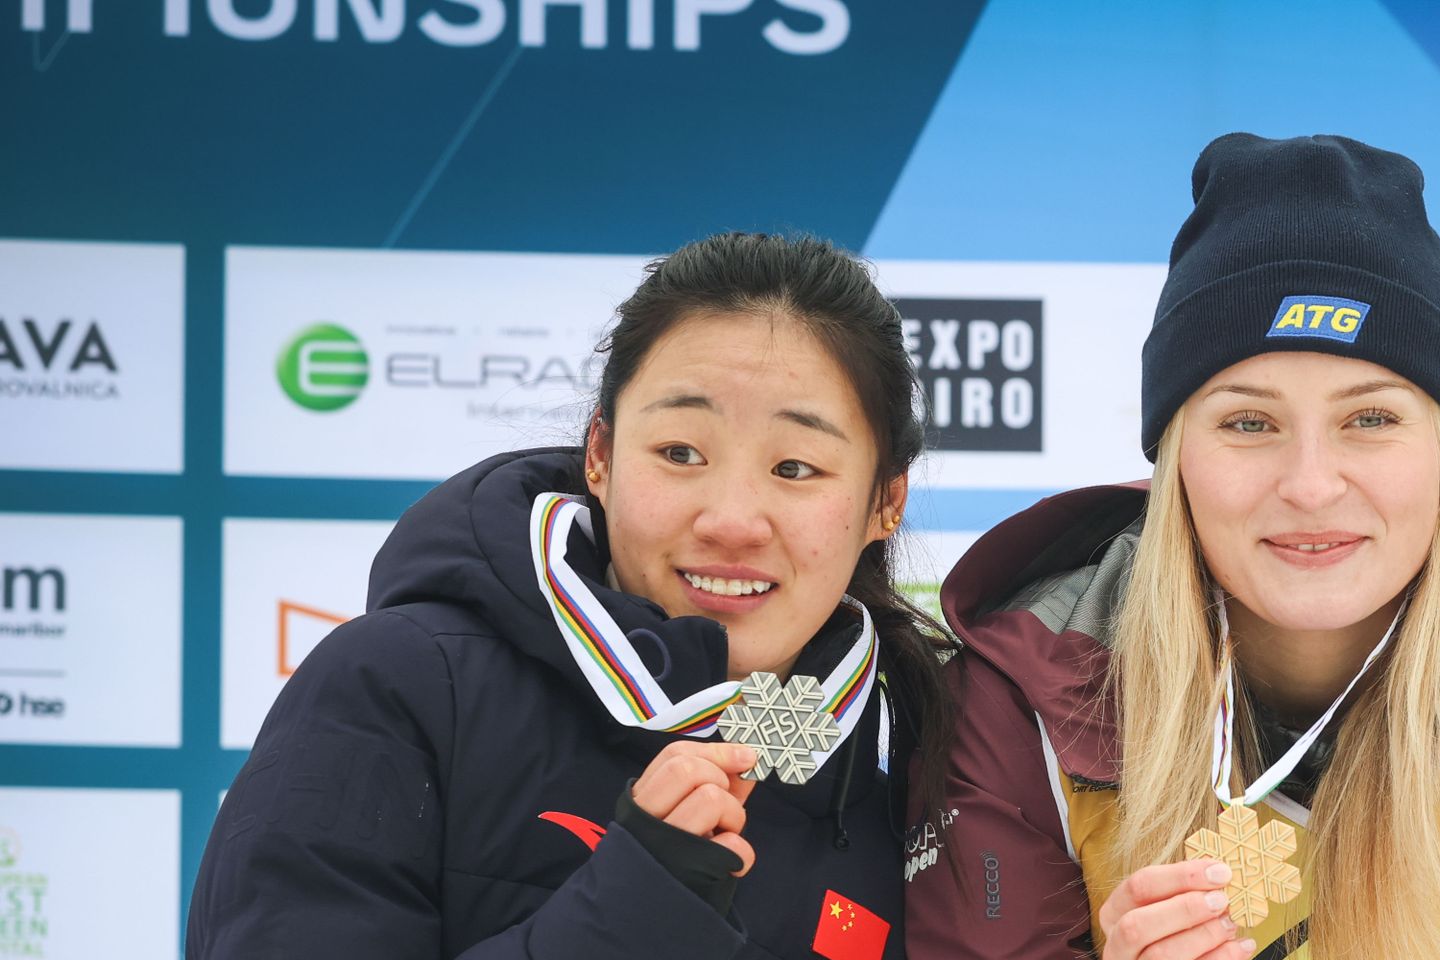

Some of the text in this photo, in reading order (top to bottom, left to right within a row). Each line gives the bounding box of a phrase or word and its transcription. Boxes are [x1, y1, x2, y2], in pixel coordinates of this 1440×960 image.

[1275, 303, 1361, 333] ATG
[904, 847, 938, 882] open
[984, 857, 1001, 918] RECCO
